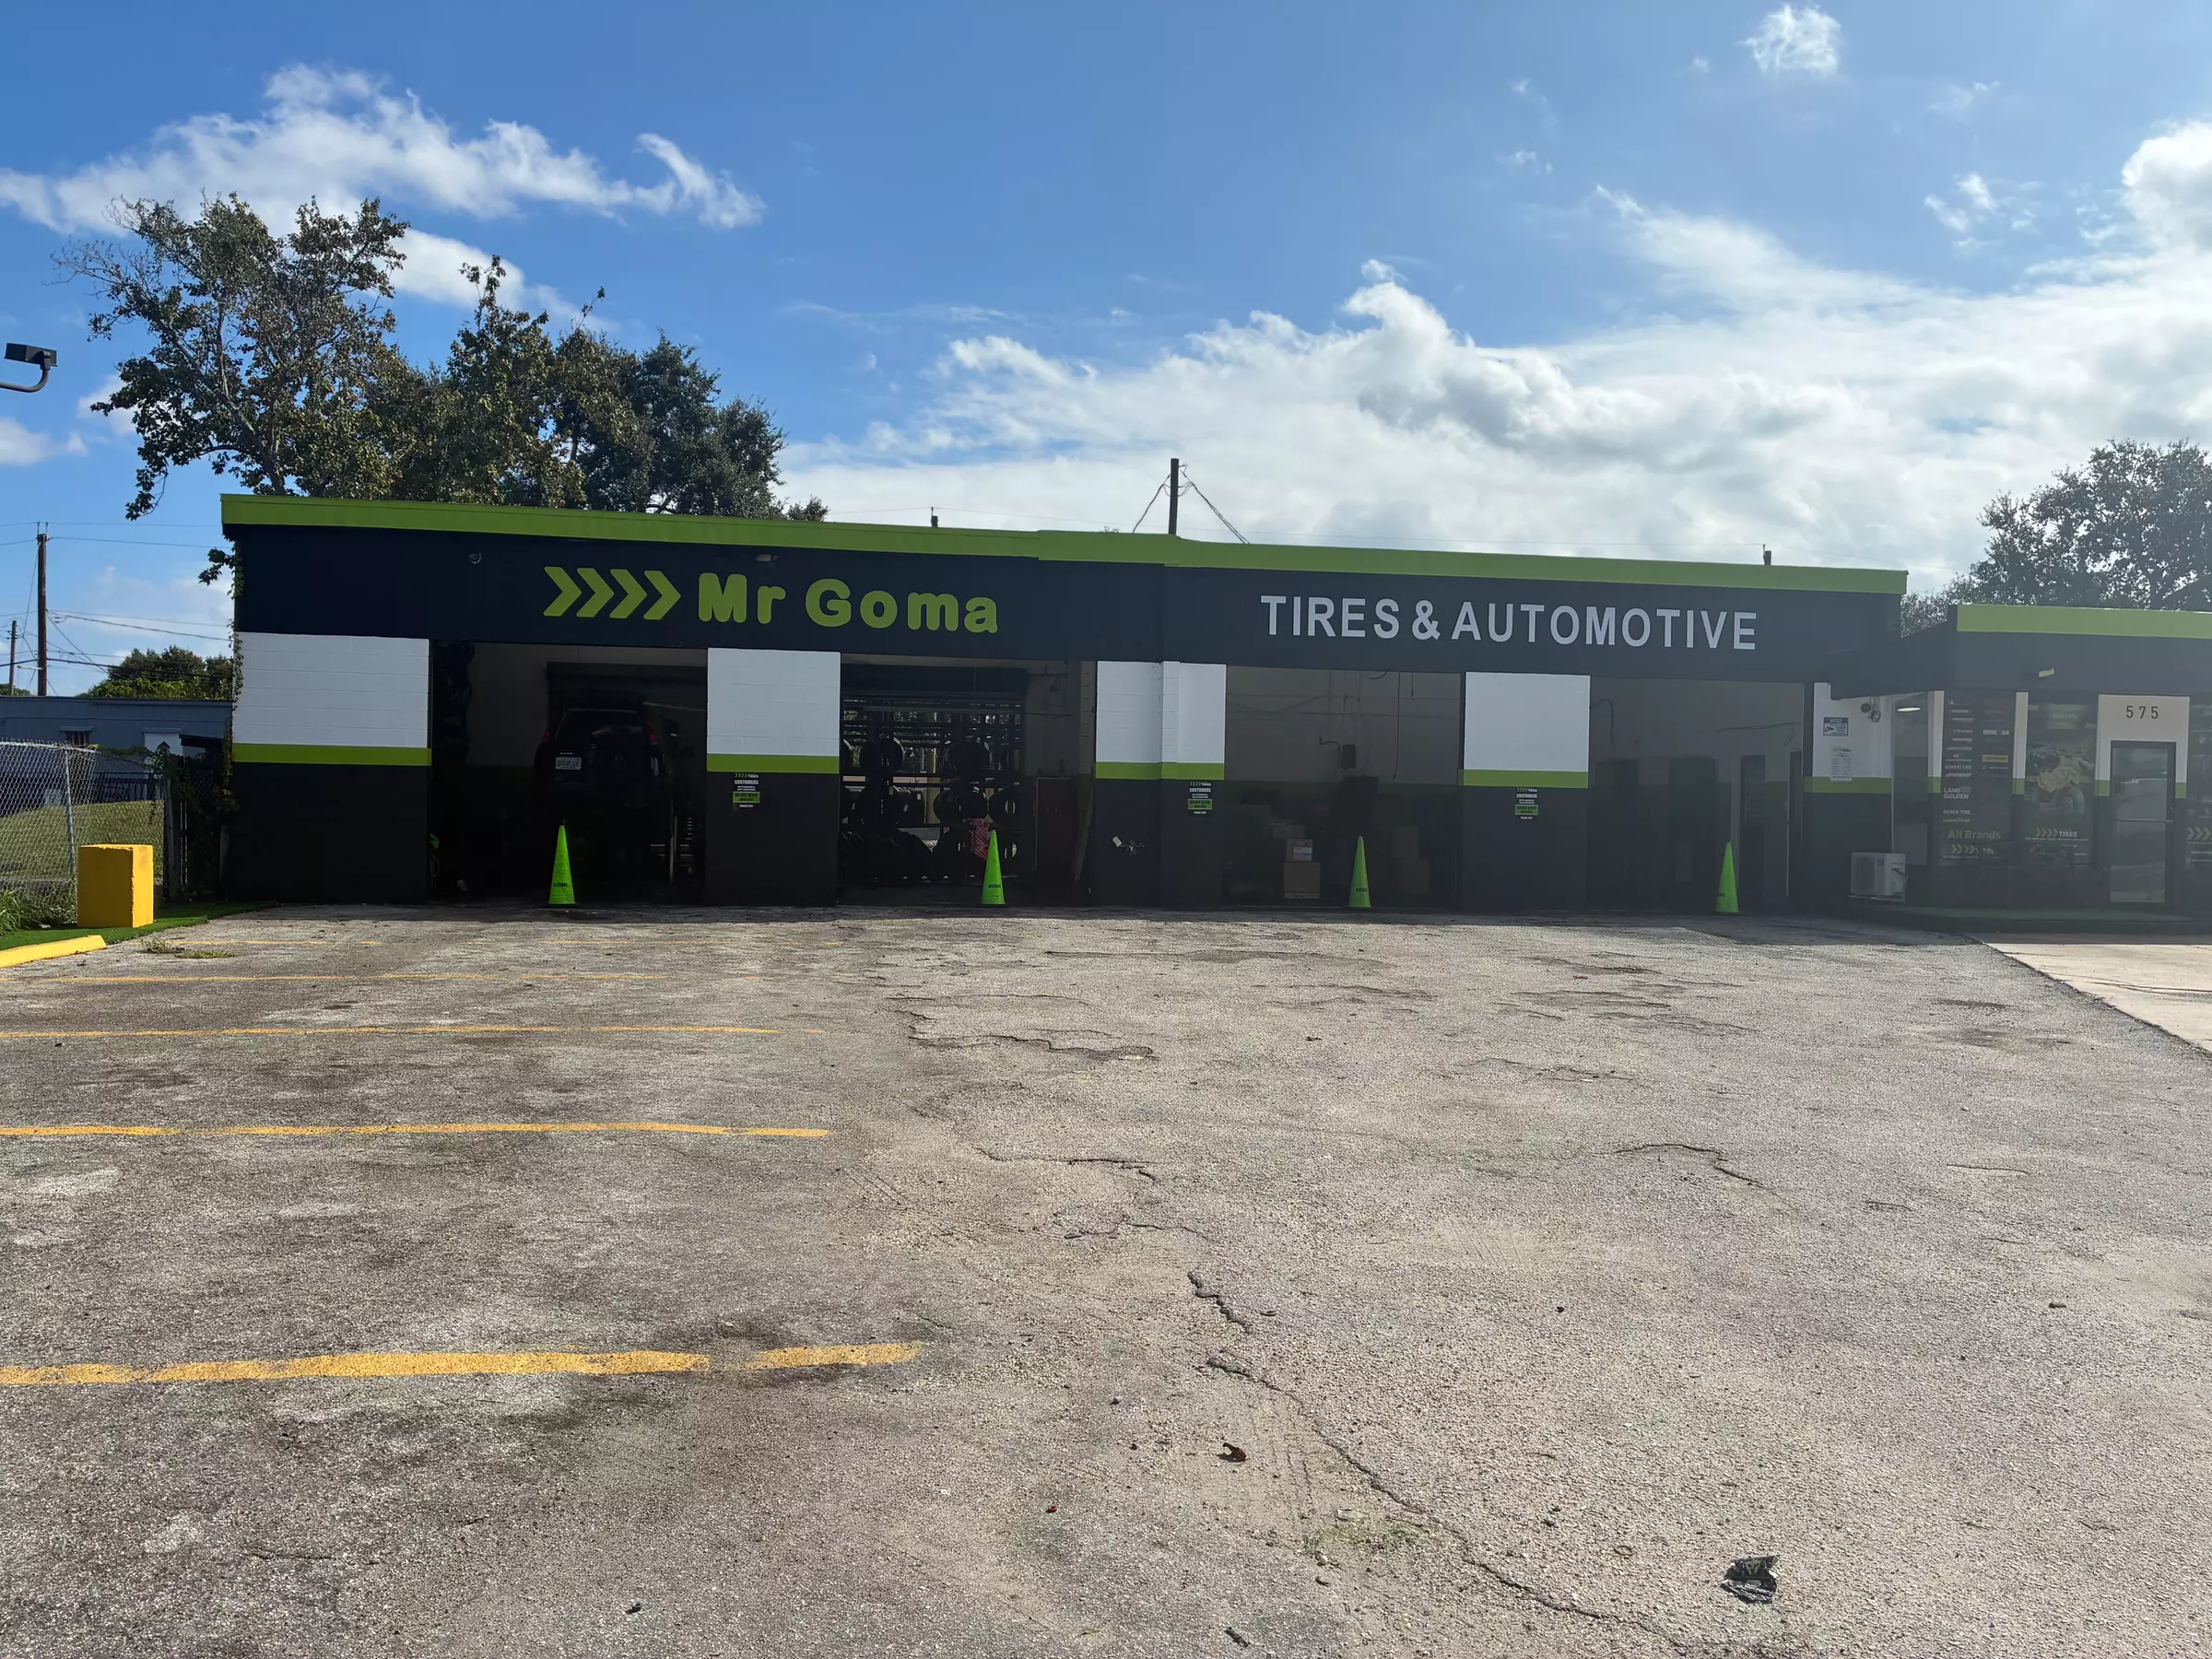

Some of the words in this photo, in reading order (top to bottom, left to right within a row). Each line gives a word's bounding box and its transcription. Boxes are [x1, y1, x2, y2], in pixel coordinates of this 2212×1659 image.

[699, 572, 785, 624] Mr
[806, 578, 998, 634] Goma
[1261, 594, 1400, 640] TIRES
[1411, 599, 1441, 641] &
[1451, 602, 1758, 651] AUTOMOTIVE
[2125, 705, 2159, 719] 575
[1947, 830, 1962, 840] All
[1964, 830, 2001, 841] Brands
